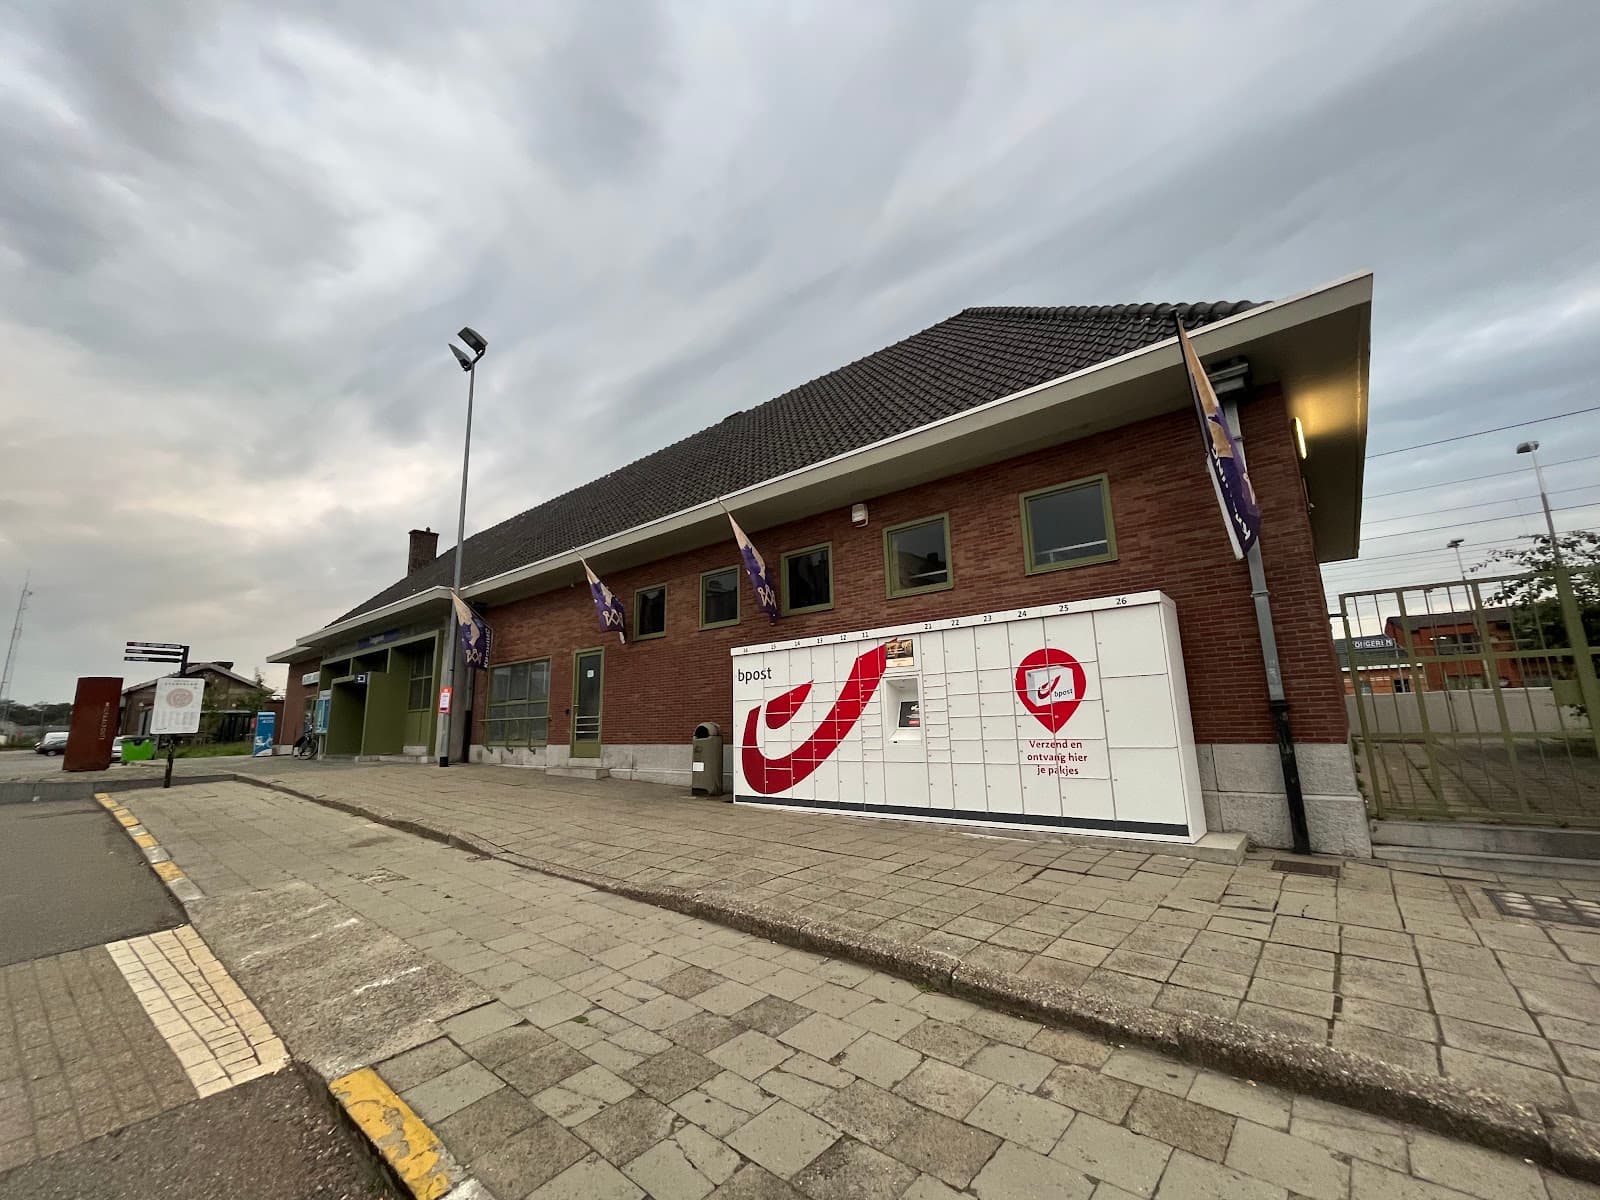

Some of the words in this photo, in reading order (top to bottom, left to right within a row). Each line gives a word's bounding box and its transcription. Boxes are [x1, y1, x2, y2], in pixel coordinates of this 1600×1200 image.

[1017, 610, 1027, 618] 24
[737, 667, 772, 684] bpost
[1054, 689, 1072, 698] bpost
[1029, 740, 1068, 749] Verzend
[1027, 753, 1066, 763] ontvang
[1068, 753, 1088, 762] hier
[1037, 765, 1046, 776] je
[1048, 766, 1079, 776] pakjes
